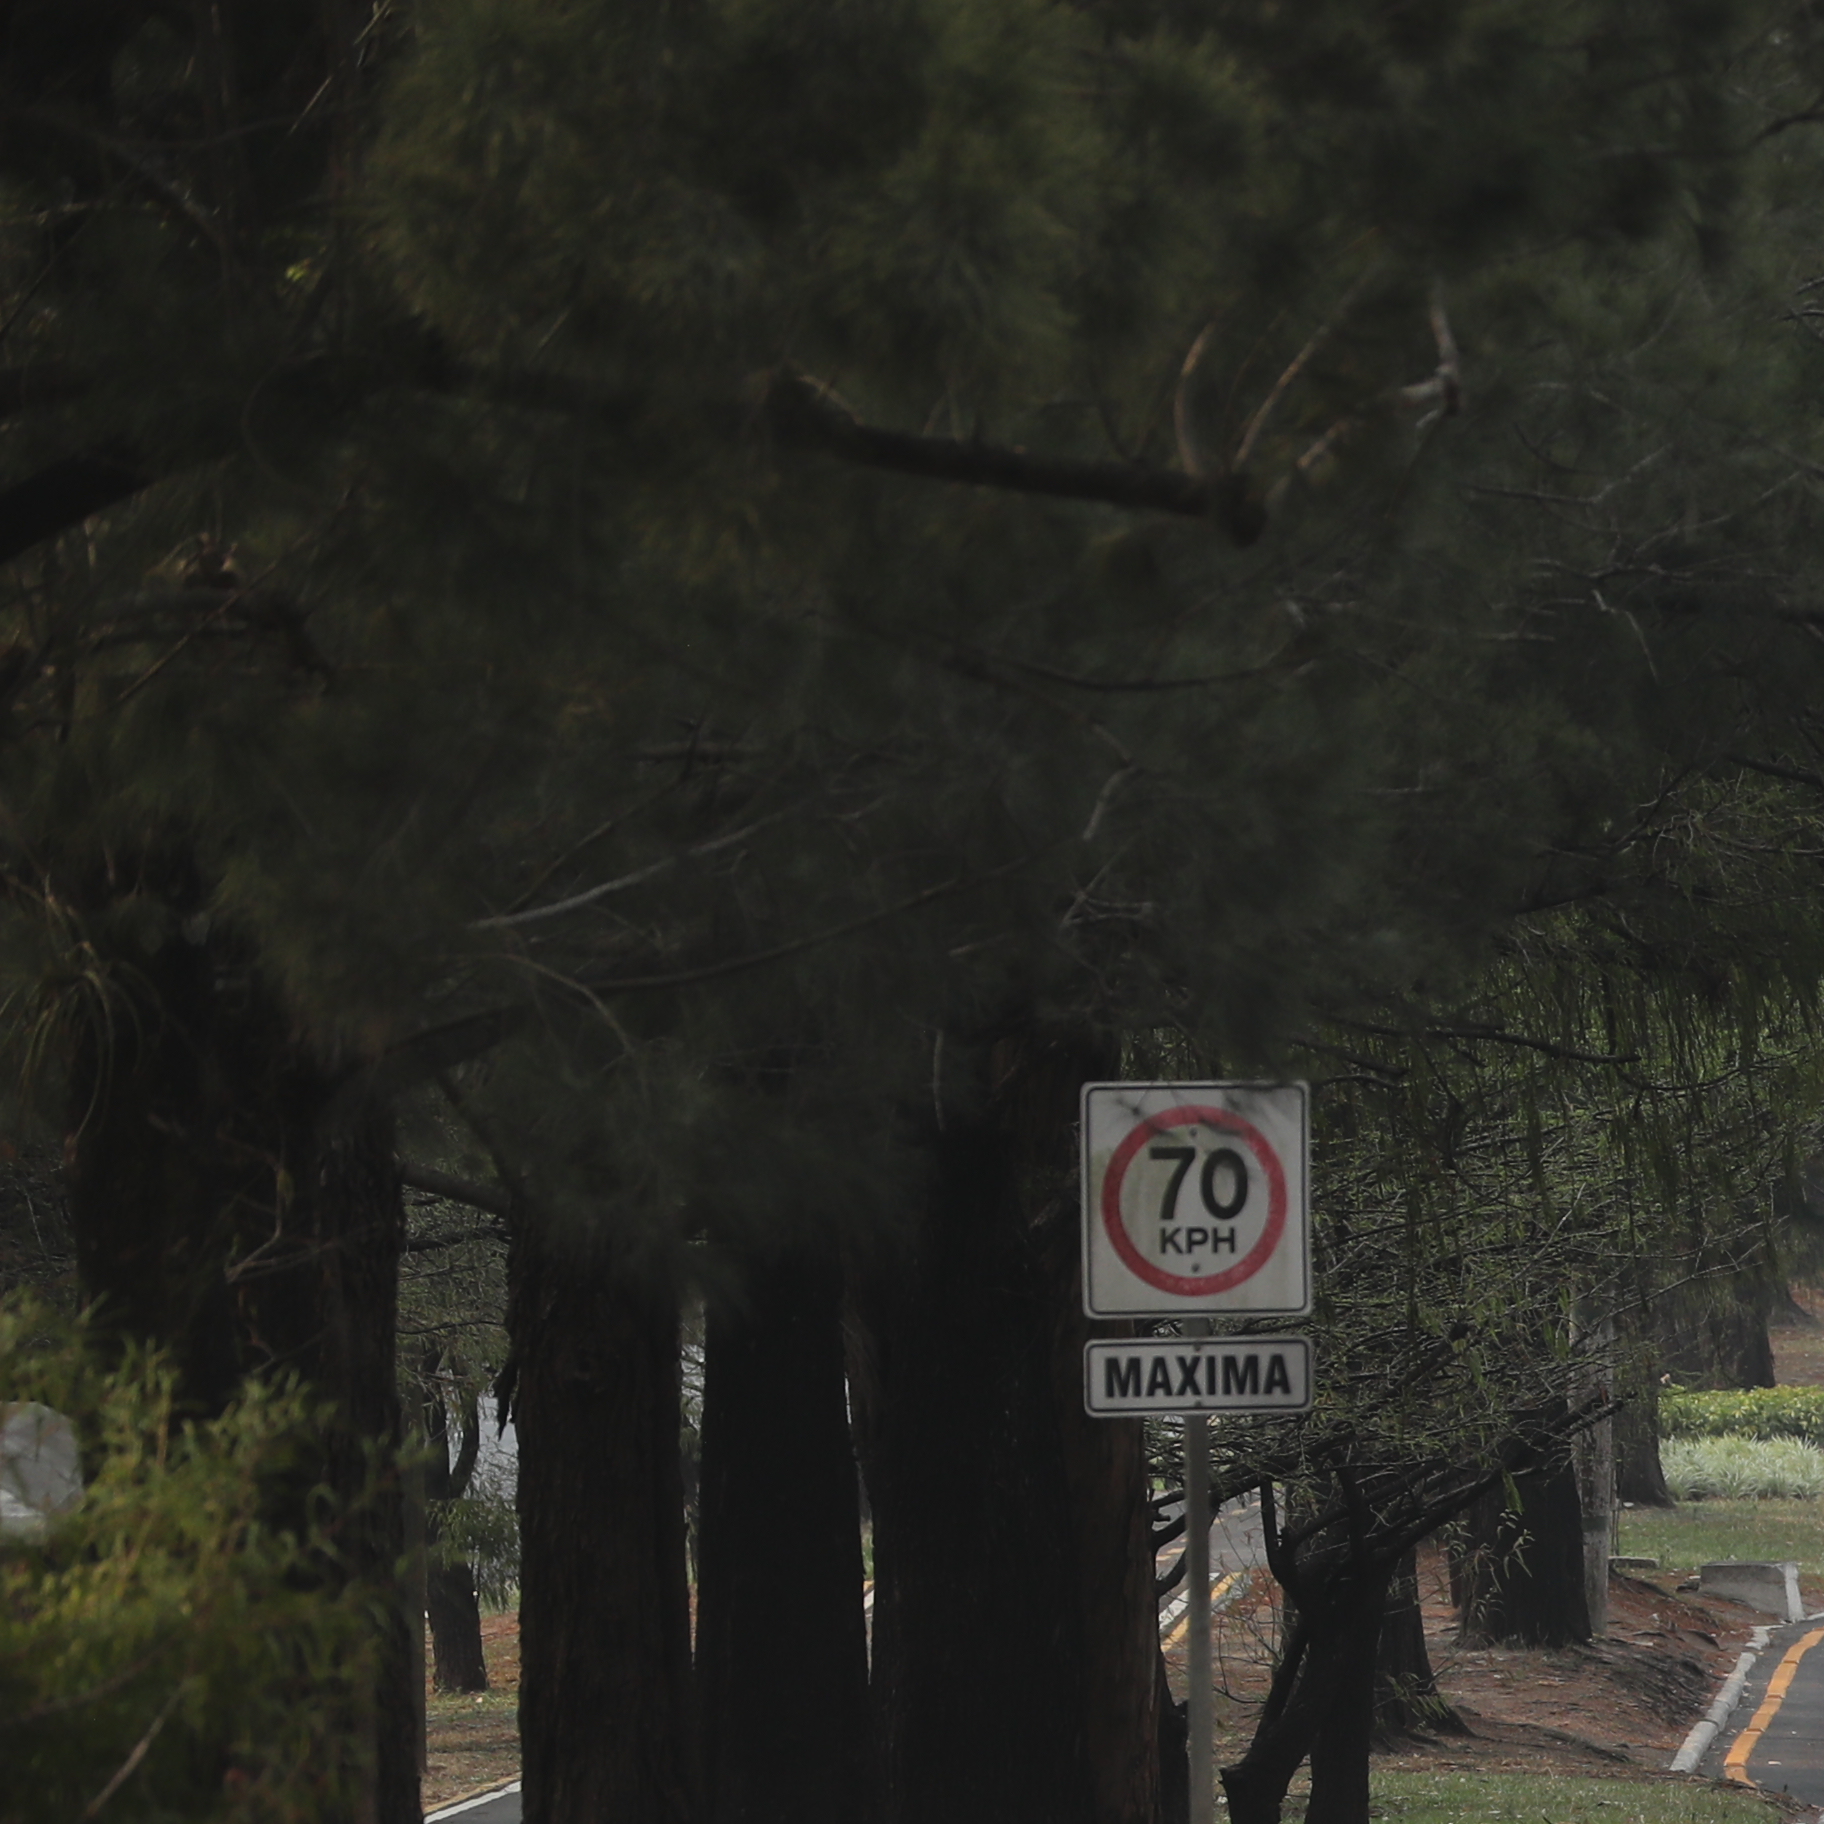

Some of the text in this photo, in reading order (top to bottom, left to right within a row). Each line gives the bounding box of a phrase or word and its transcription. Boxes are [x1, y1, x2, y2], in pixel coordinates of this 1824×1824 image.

[1149, 1147, 1249, 1220] 70
[1160, 1227, 1236, 1254] KPH
[1104, 1355, 1291, 1398] MAXIMA
